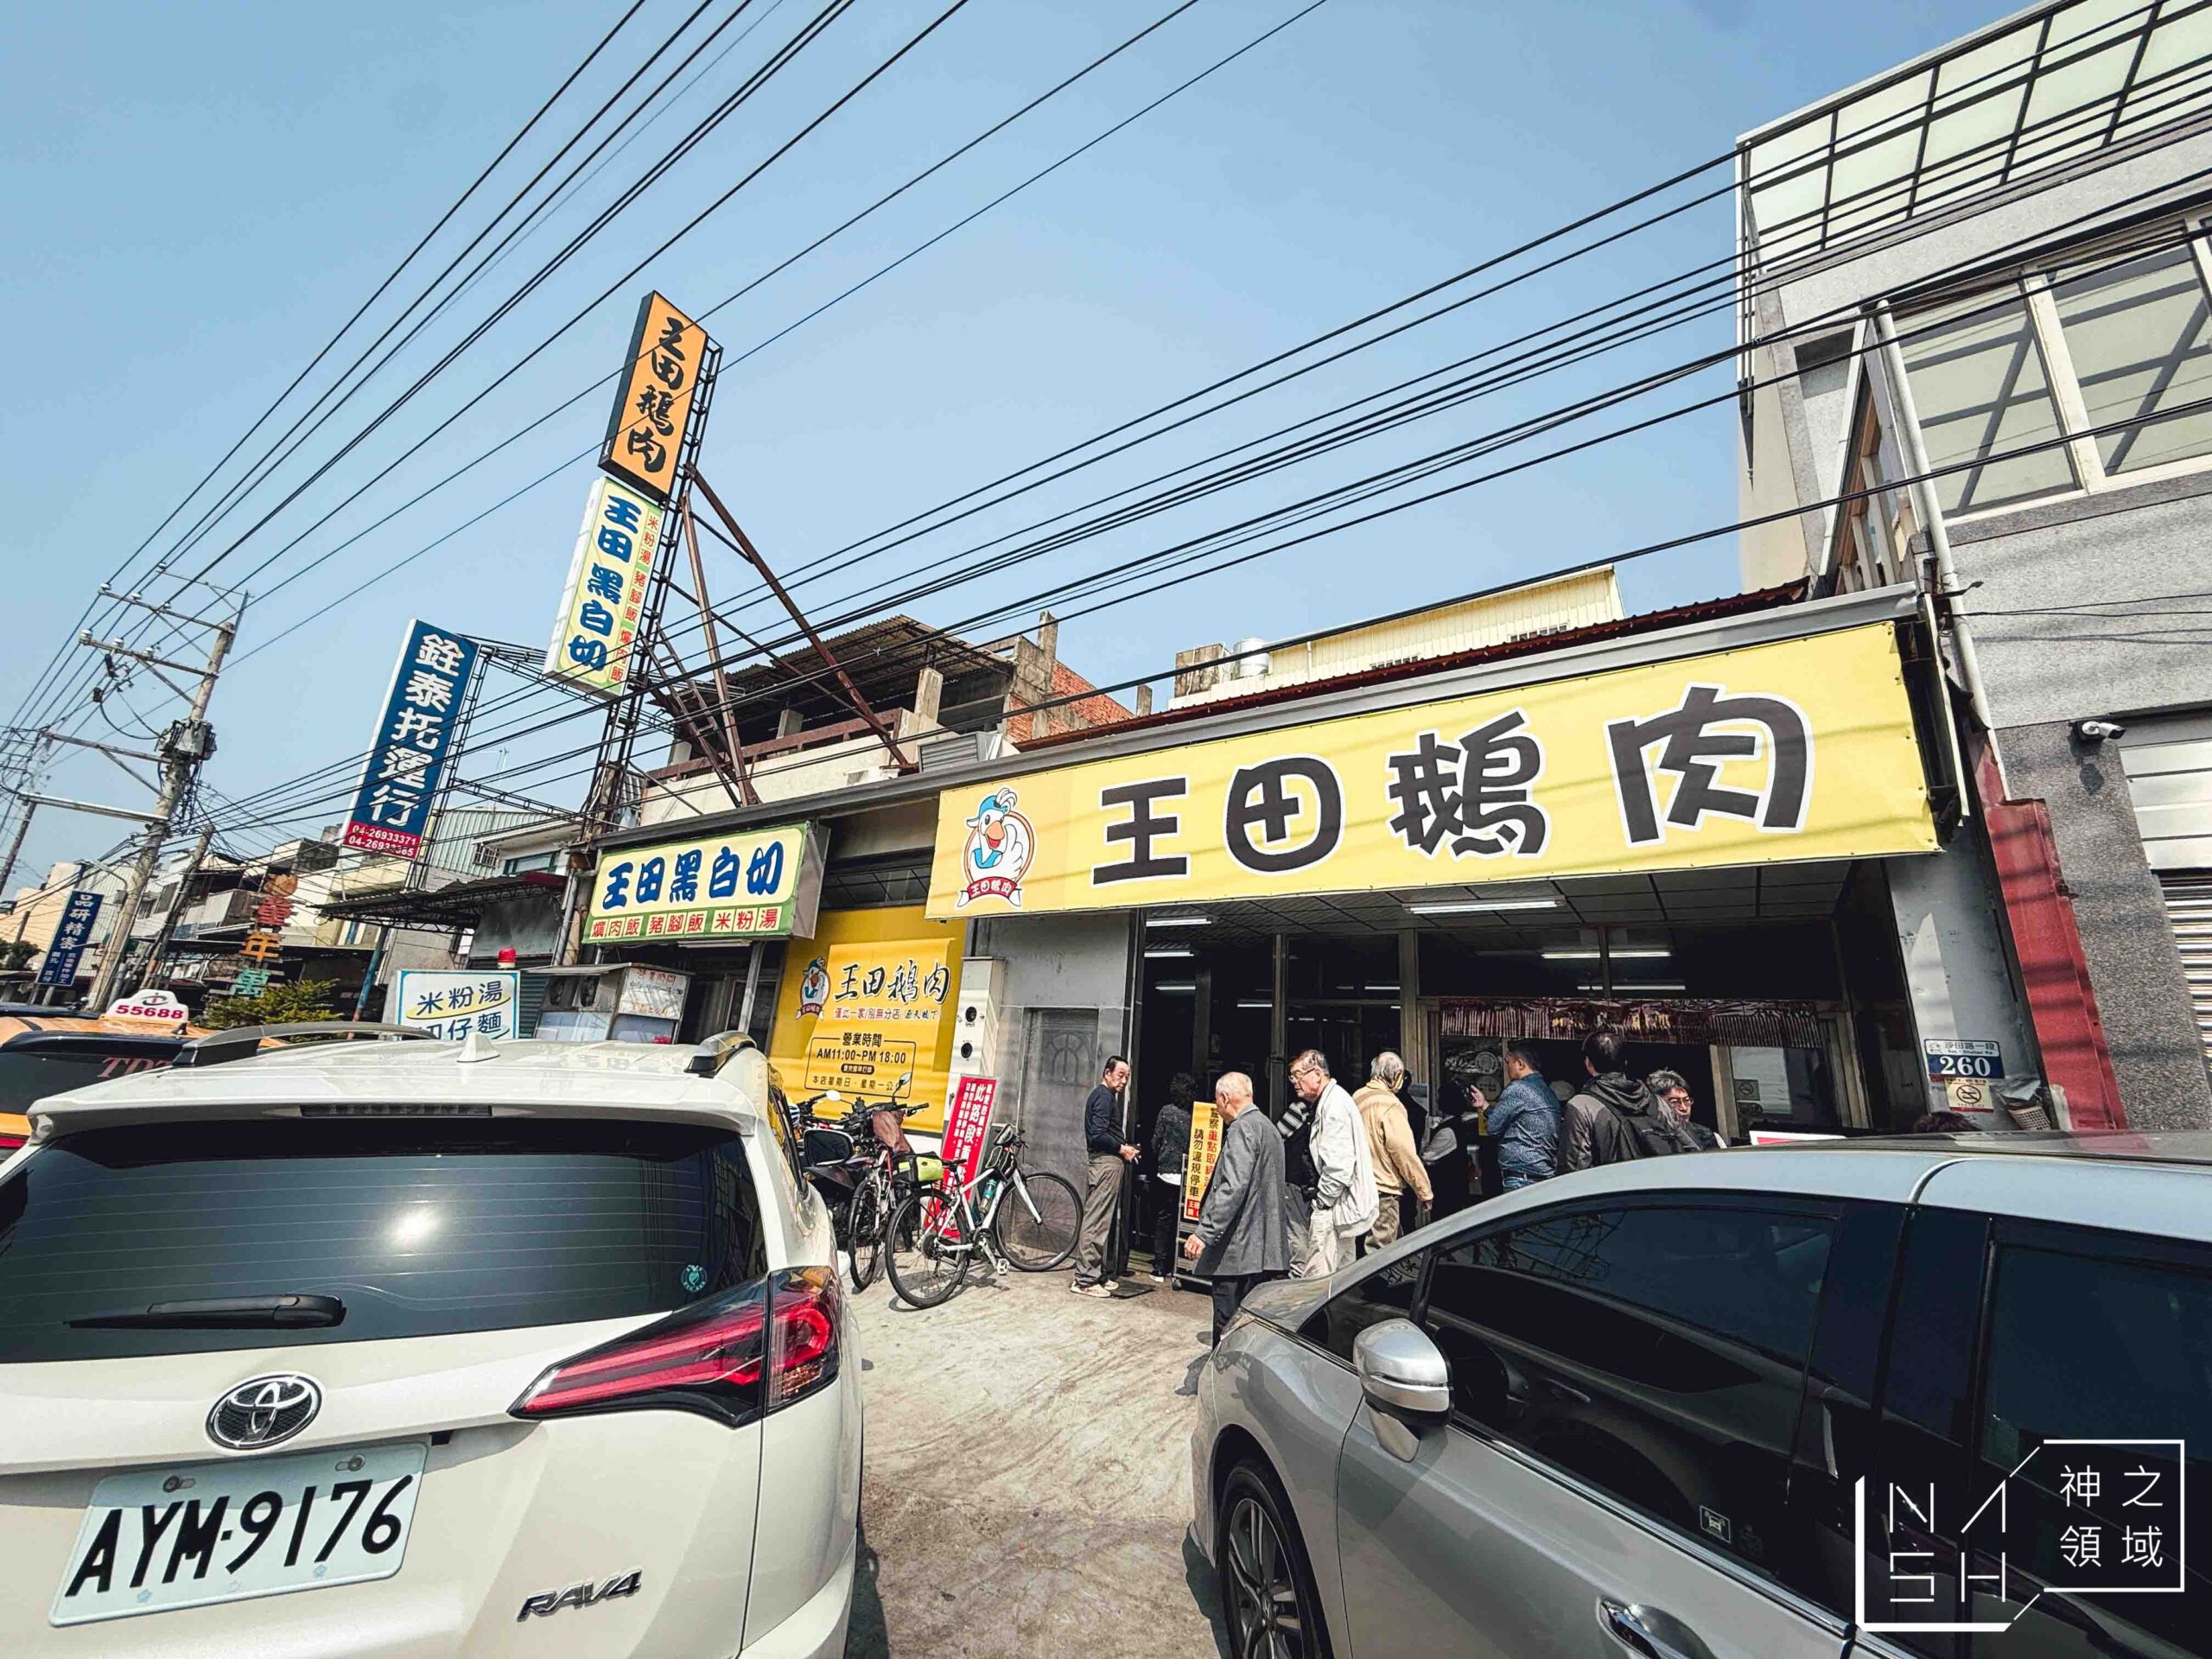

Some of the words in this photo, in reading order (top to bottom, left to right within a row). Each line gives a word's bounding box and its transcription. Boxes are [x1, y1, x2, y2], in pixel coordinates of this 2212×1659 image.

[625, 315, 686, 473] 王田鵝肉
[639, 515, 659, 565] 米粉湯
[569, 494, 642, 672] 王田黑白切
[624, 570, 648, 623] 豬腳飯
[371, 632, 465, 828] 銓泰托運行
[1093, 686, 1808, 885] 王田鵝肉
[602, 841, 785, 910] 王田黑白切
[648, 913, 703, 933] 豬腳飯
[714, 908, 779, 931] 米粉湯
[416, 980, 503, 1016] 米粉湯
[834, 960, 951, 1005] 王田鵝肉
[116, 1004, 184, 1020] 55688
[842, 1032, 882, 1048] 營業時間
[880, 1051, 906, 1065] 18:00
[1939, 1055, 1991, 1077] 260
[64, 1474, 414, 1598] AYM-9176
[517, 1568, 642, 1623] RAV4
